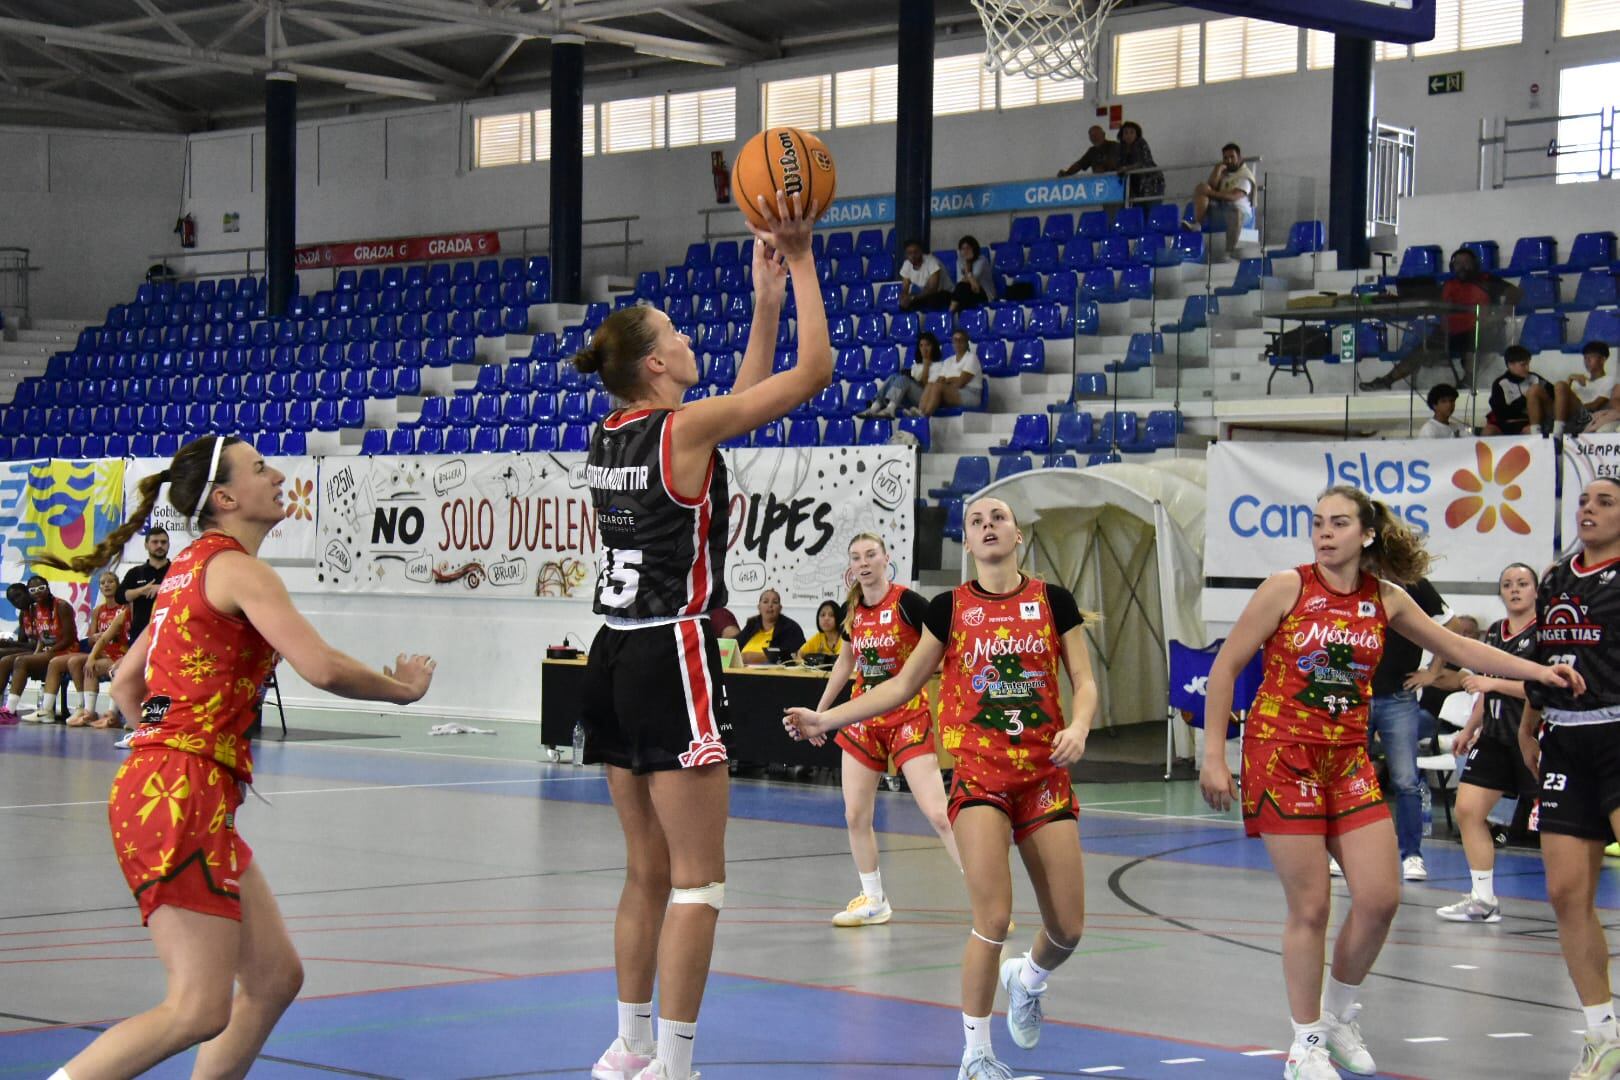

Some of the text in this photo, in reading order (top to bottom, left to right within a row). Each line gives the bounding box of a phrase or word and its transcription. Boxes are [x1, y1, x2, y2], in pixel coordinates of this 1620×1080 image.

[778, 132, 803, 197] Wilson
[930, 192, 991, 212] RADA F
[1024, 182, 1104, 204] GRADA F
[877, 202, 887, 217] F
[296, 251, 320, 264] ADA
[353, 245, 395, 260] GRADA
[428, 238, 486, 255] GRADA G
[326, 464, 355, 505] #25N
[876, 471, 897, 497] PUTA
[1325, 452, 1432, 494] Islas
[371, 491, 835, 563] NO SOLO DUELEN OLPES
[1229, 495, 1430, 539] Cans
[1570, 628, 1601, 641] TIAS
[964, 634, 1047, 669] Móstoles
[1004, 709, 1024, 736] 3
[1543, 772, 1567, 791] 23
